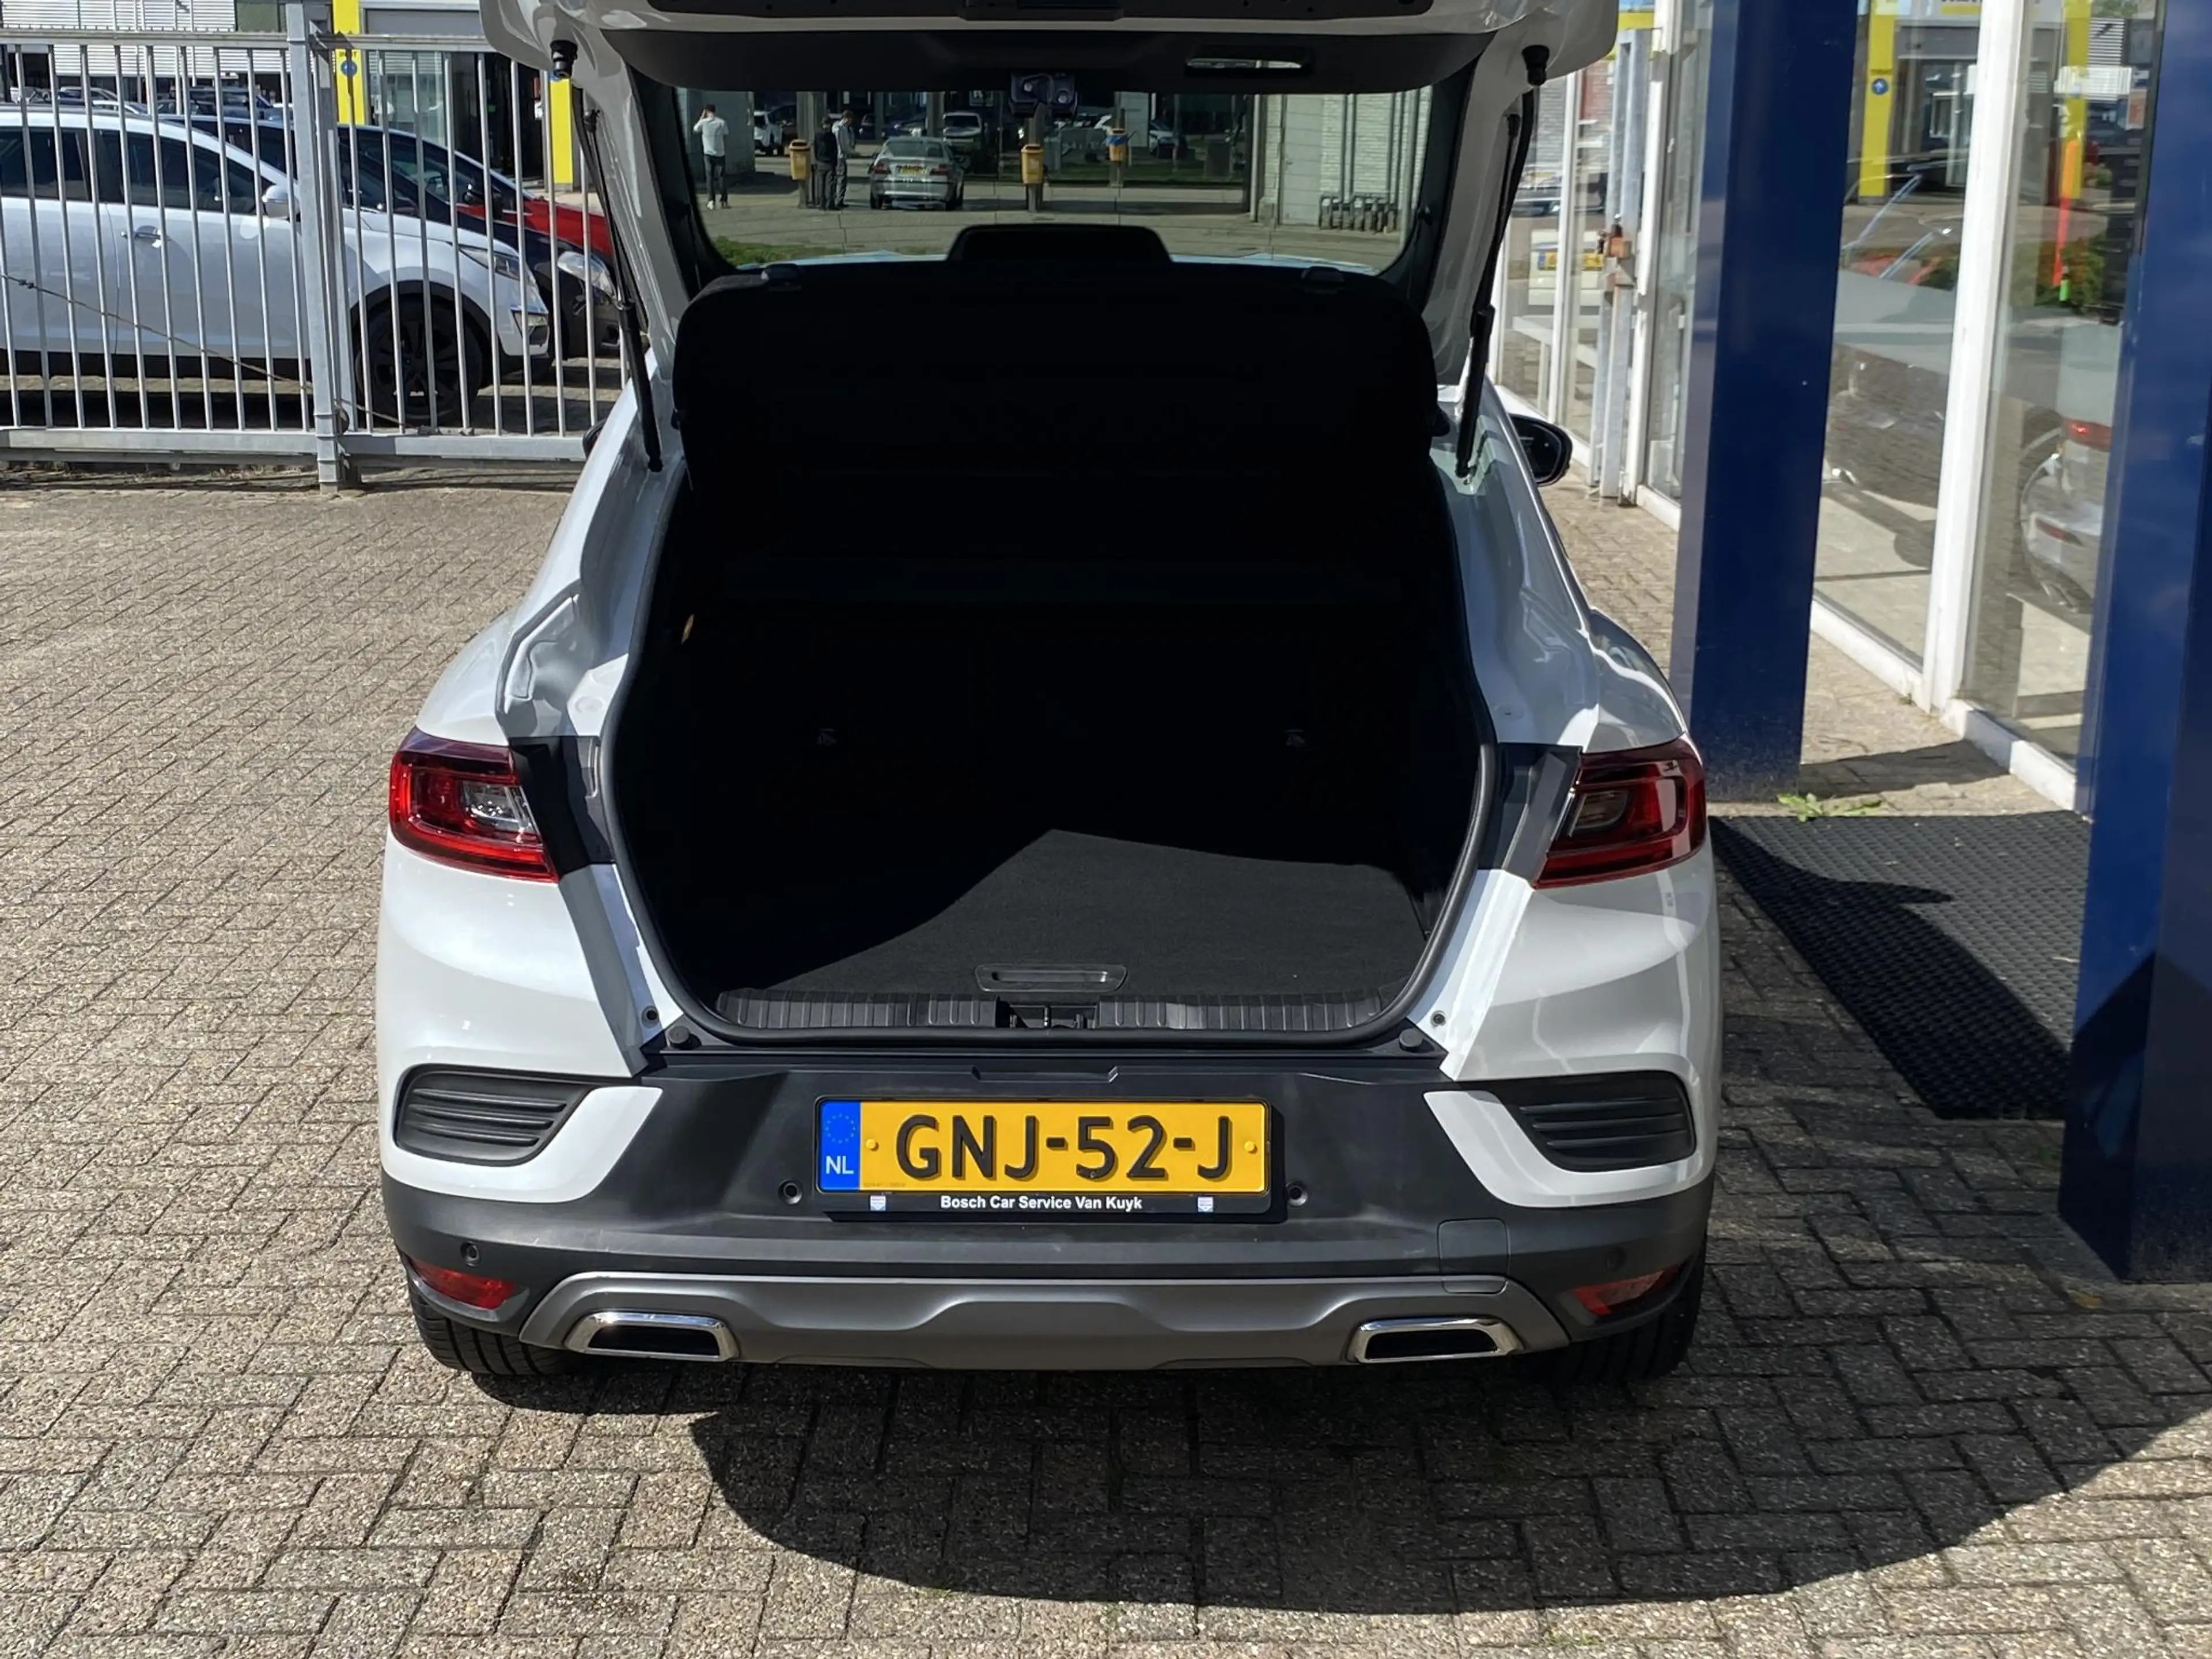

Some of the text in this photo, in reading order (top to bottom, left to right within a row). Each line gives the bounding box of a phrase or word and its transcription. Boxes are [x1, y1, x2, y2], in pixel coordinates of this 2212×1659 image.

[896, 1114, 1229, 1180] GNJ-52-J
[825, 1155, 854, 1175] NL
[940, 1195, 1143, 1212] Bosch Car Service Van Kuyk
